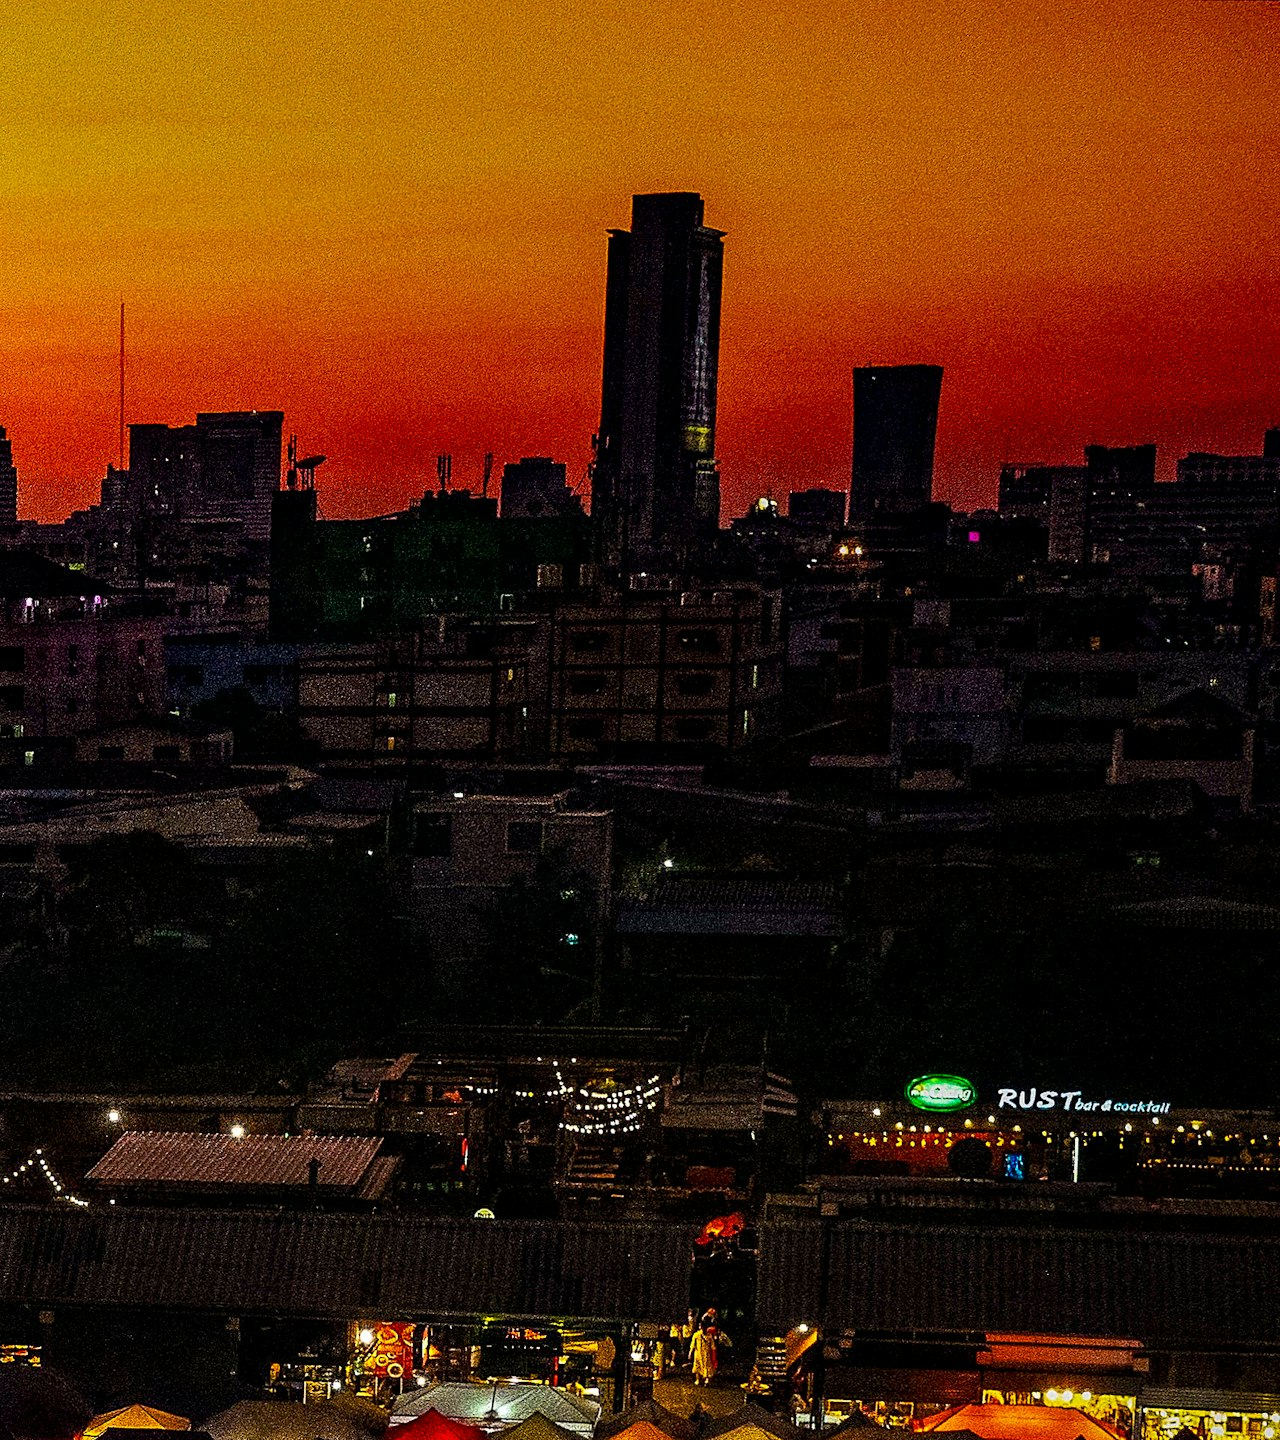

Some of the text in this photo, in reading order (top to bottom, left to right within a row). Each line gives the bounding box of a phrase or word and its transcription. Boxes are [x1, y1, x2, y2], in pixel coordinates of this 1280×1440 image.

[997, 1087, 1171, 1115] RUST bar & cocktail
